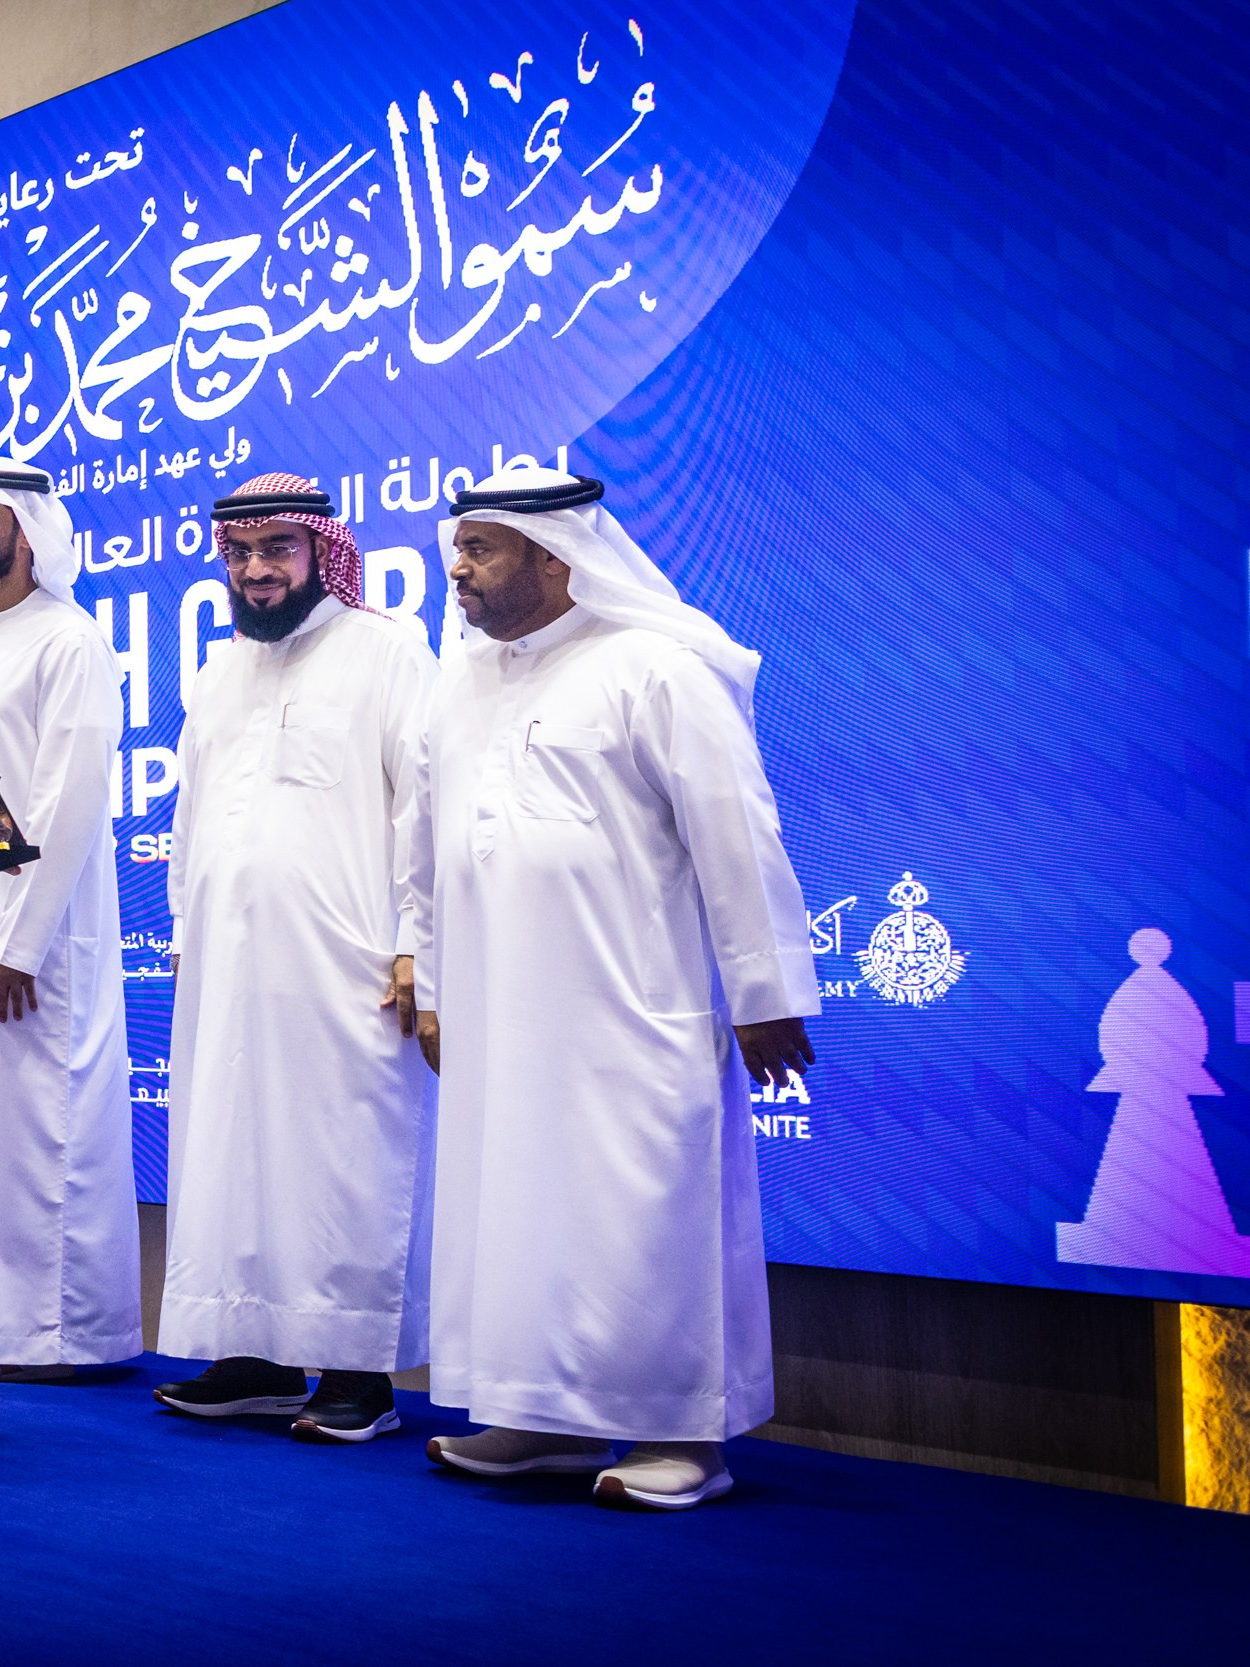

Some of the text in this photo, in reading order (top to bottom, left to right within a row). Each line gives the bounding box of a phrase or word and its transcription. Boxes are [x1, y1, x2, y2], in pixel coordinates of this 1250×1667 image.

[65, 127, 145, 190] تحت
[91, 448, 147, 495] إمارة
[154, 447, 201, 479] عهد
[208, 426, 251, 479] ولي
